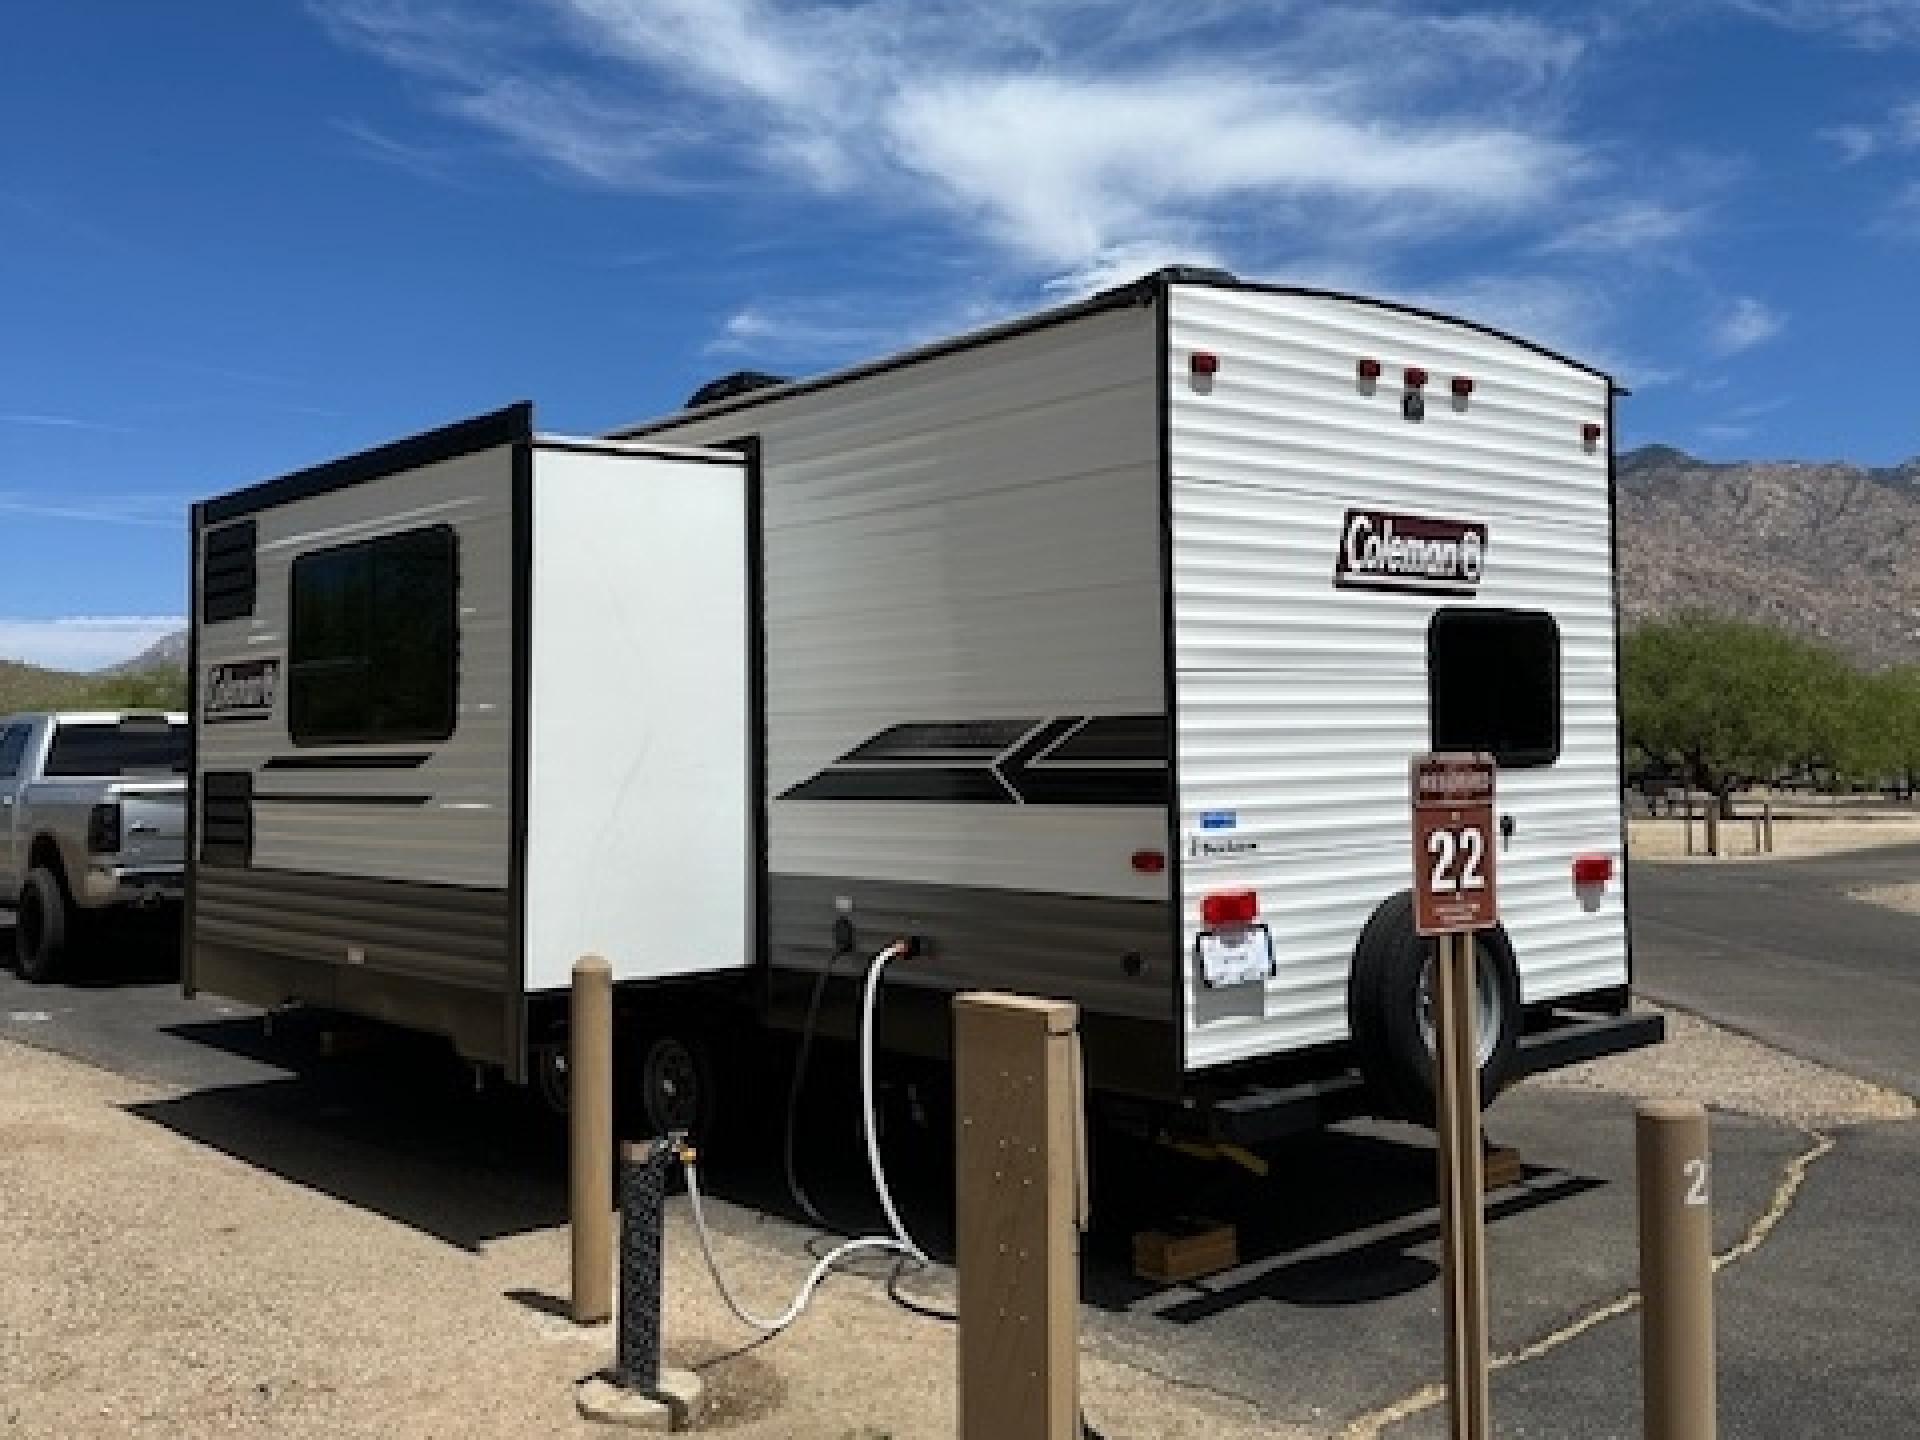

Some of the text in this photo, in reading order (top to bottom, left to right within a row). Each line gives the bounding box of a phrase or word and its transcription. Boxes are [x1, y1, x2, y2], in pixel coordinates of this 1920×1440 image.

[1346, 515, 1458, 577] Coleman
[1428, 827, 1485, 892] 22
[1683, 1159, 1709, 1205] 2
